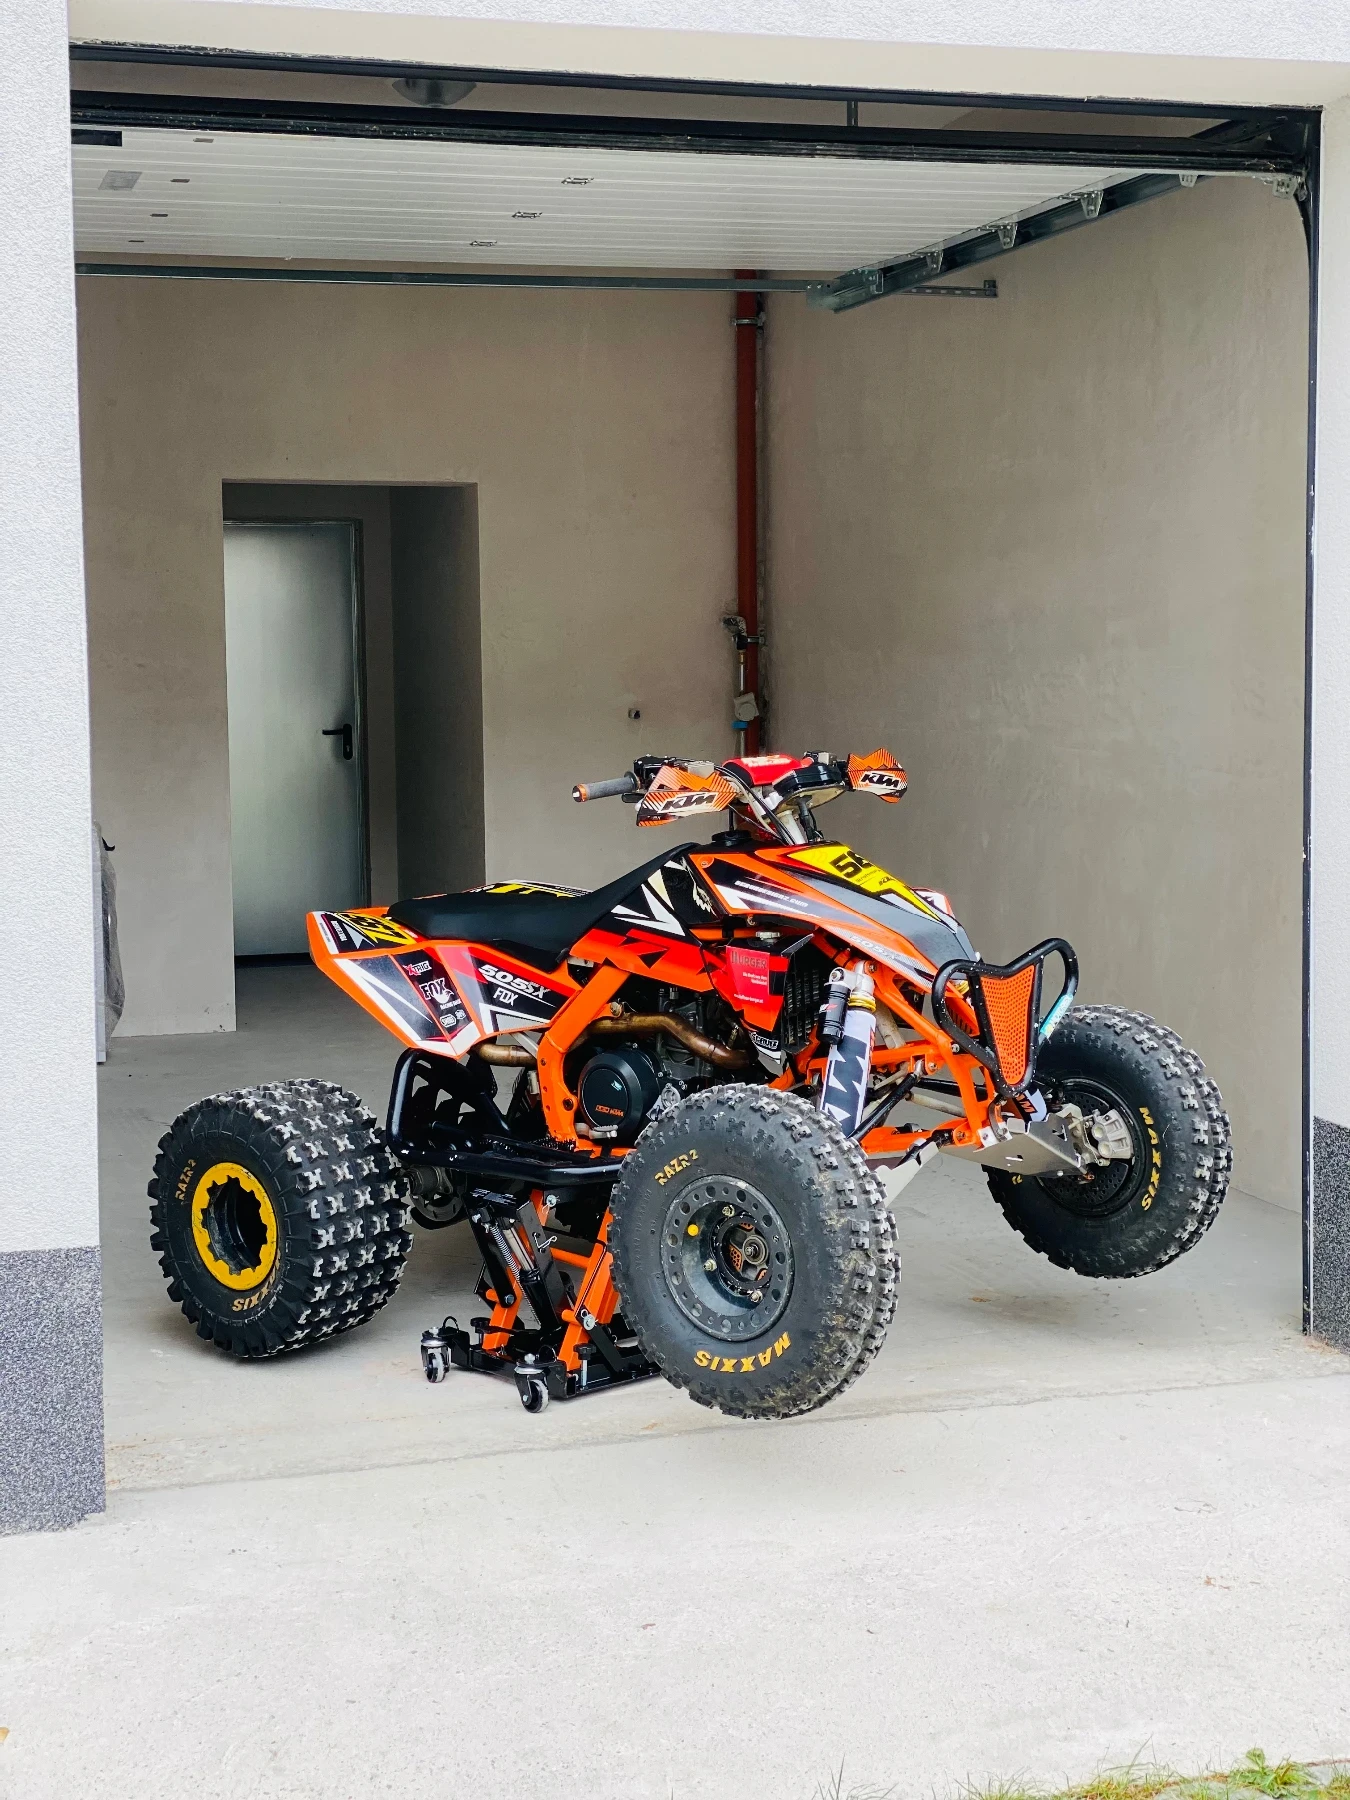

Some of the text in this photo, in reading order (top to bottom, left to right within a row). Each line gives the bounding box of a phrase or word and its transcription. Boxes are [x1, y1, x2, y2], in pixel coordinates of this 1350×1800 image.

[860, 772, 900, 788] KTM
[661, 793, 718, 812] KTM
[403, 961, 432, 976] XTRIG
[731, 951, 767, 969] BURGER
[419, 978, 447, 1001] FOX
[493, 987, 519, 1007] FOX
[654, 1148, 699, 1187] RAZR 2
[1138, 1106, 1162, 1211] MAXXIS
[175, 1159, 197, 1200] RAZR 2
[693, 1330, 792, 1374] MAXXIS
